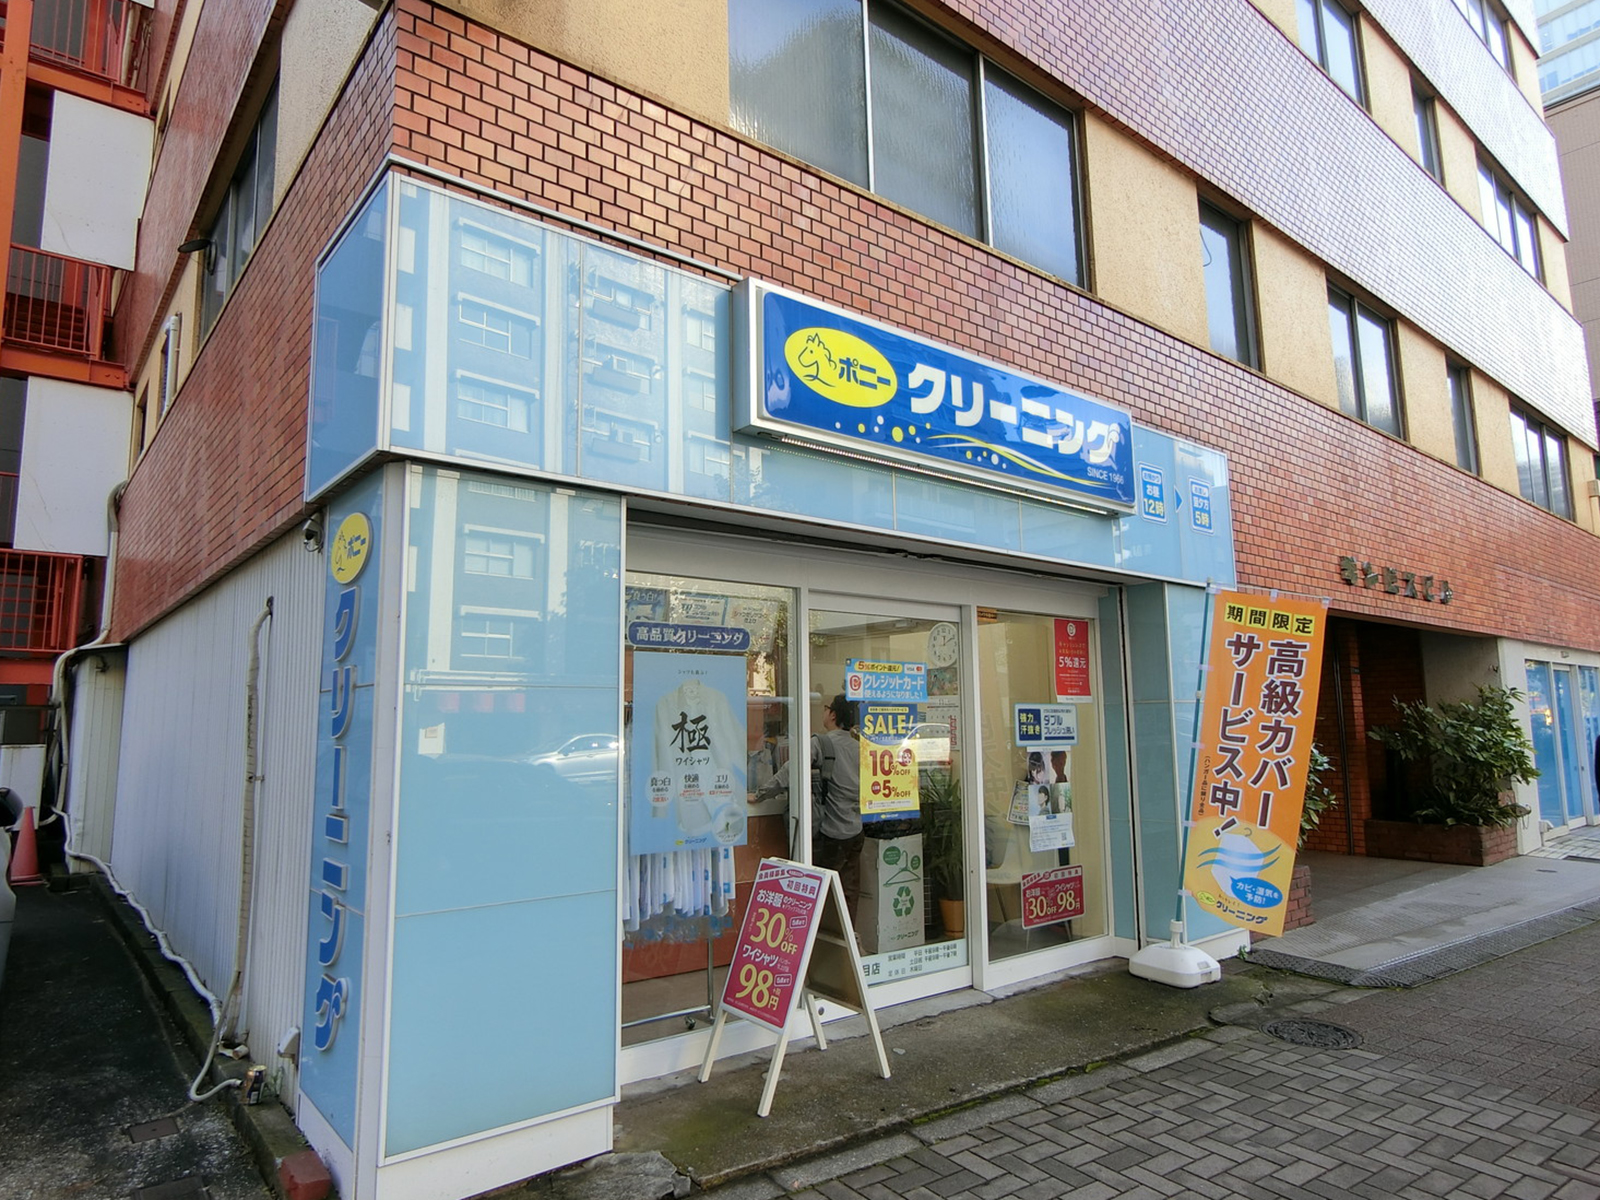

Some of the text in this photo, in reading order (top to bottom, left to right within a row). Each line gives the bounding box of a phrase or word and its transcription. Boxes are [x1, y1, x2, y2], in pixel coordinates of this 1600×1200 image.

[838, 358, 892, 391] ポニー
[907, 361, 1120, 464] クリーニング
[1087, 466, 1109, 480] SINCE
[347, 534, 367, 559] ポニー
[1227, 604, 1313, 635] 期間限定
[636, 625, 744, 646] 高品質クリーニング
[863, 675, 925, 690] クレジットカード
[670, 711, 711, 753] 極
[863, 714, 914, 735] SALE!
[1209, 633, 1263, 836] サービス中!
[1248, 640, 1309, 827] 高級カバー
[675, 756, 710, 766] ワイシャツ
[314, 585, 361, 1051] クリーニング
[1056, 890, 1076, 913] 98
[1216, 900, 1269, 925] クリーニング
[742, 945, 779, 967] ワイシャツ
[780, 941, 798, 955] OFF
[735, 963, 774, 1009] 98
[768, 995, 779, 1011] 円
